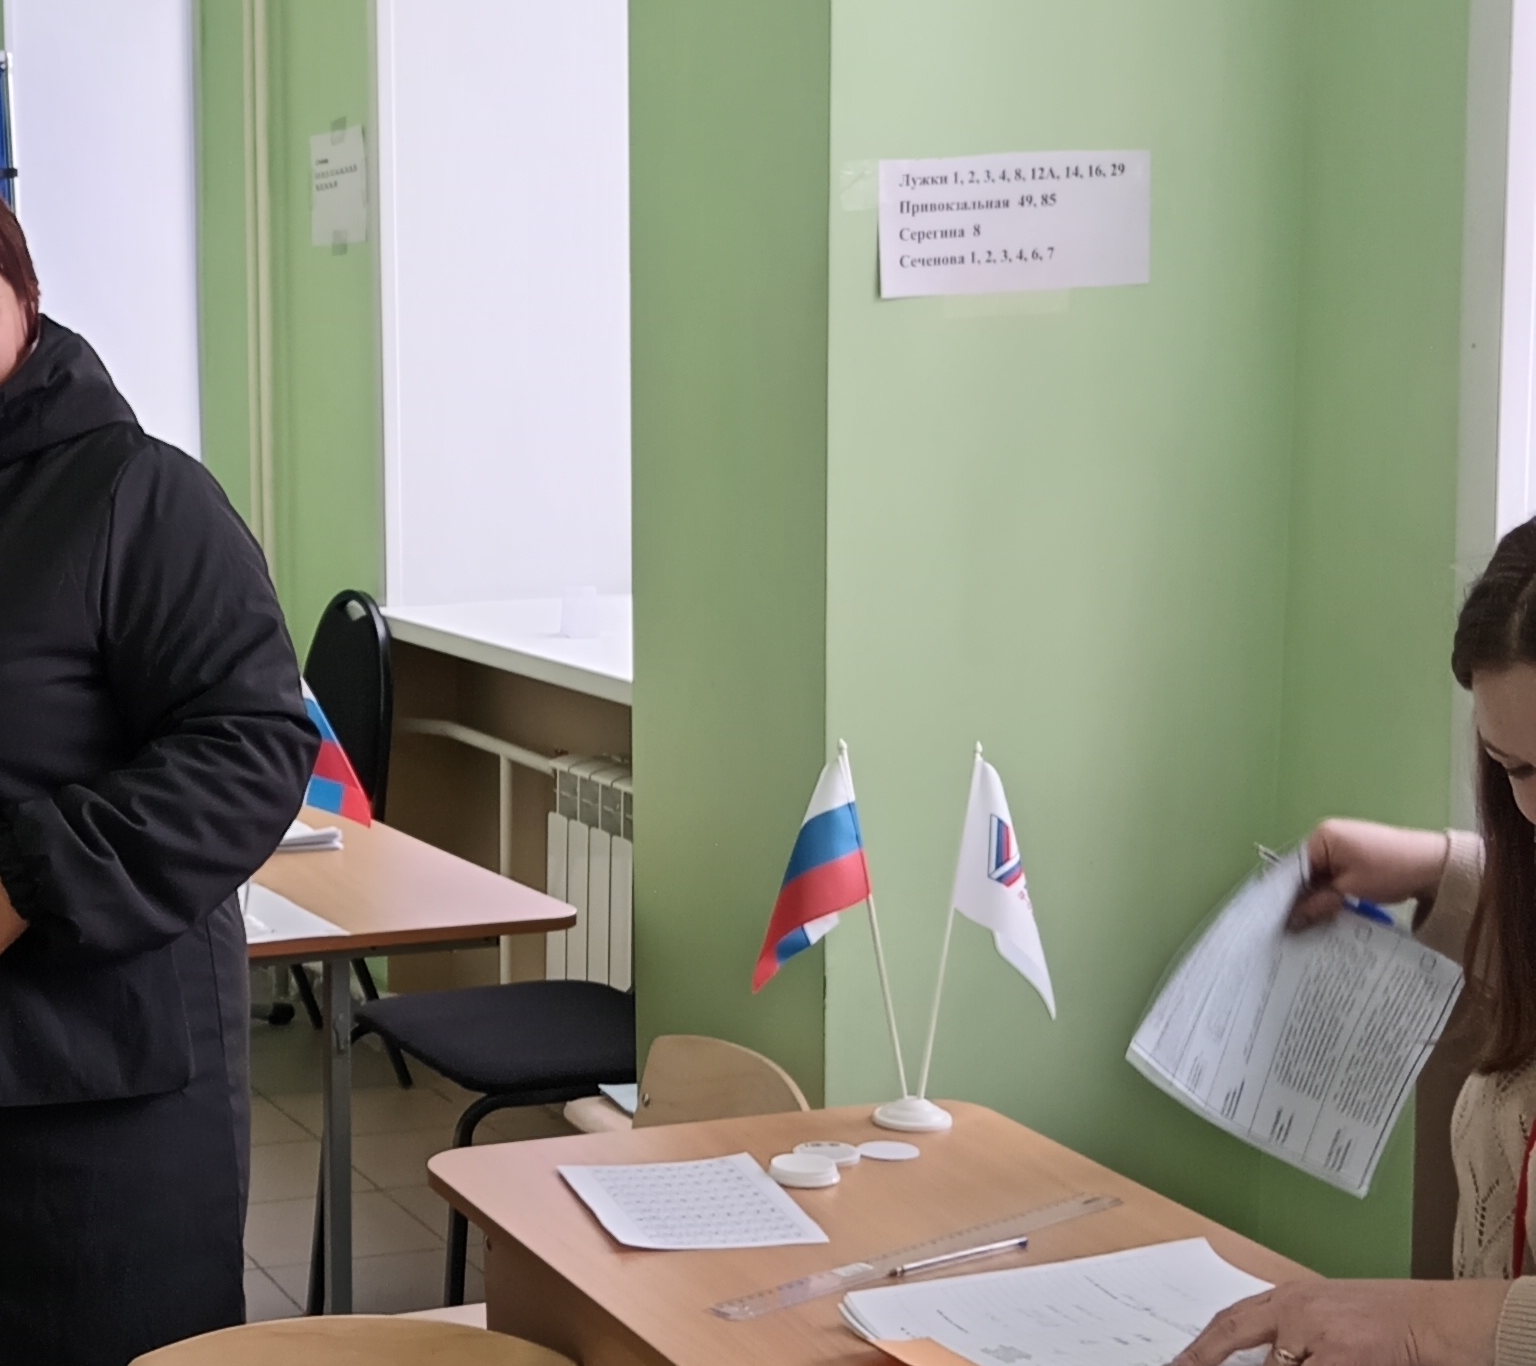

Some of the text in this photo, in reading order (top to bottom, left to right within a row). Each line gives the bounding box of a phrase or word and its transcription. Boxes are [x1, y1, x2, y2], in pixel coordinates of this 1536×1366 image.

[898, 172, 949, 190] Лужки
[953, 171, 965, 186] 1,
[968, 170, 980, 185] 2,
[983, 169, 995, 184] 3,
[998, 168, 1011, 183] 4,
[1014, 167, 1026, 182] 8,
[1065, 165, 1084, 179] 14,
[1088, 164, 1106, 178] 16,
[1110, 163, 1125, 177] 29
[899, 193, 1057, 216] Привокзальная 49, 85
[899, 223, 981, 243] Серегина 8
[899, 246, 1055, 268] Сеченова 1, 2, 3, 4, 6, 7
